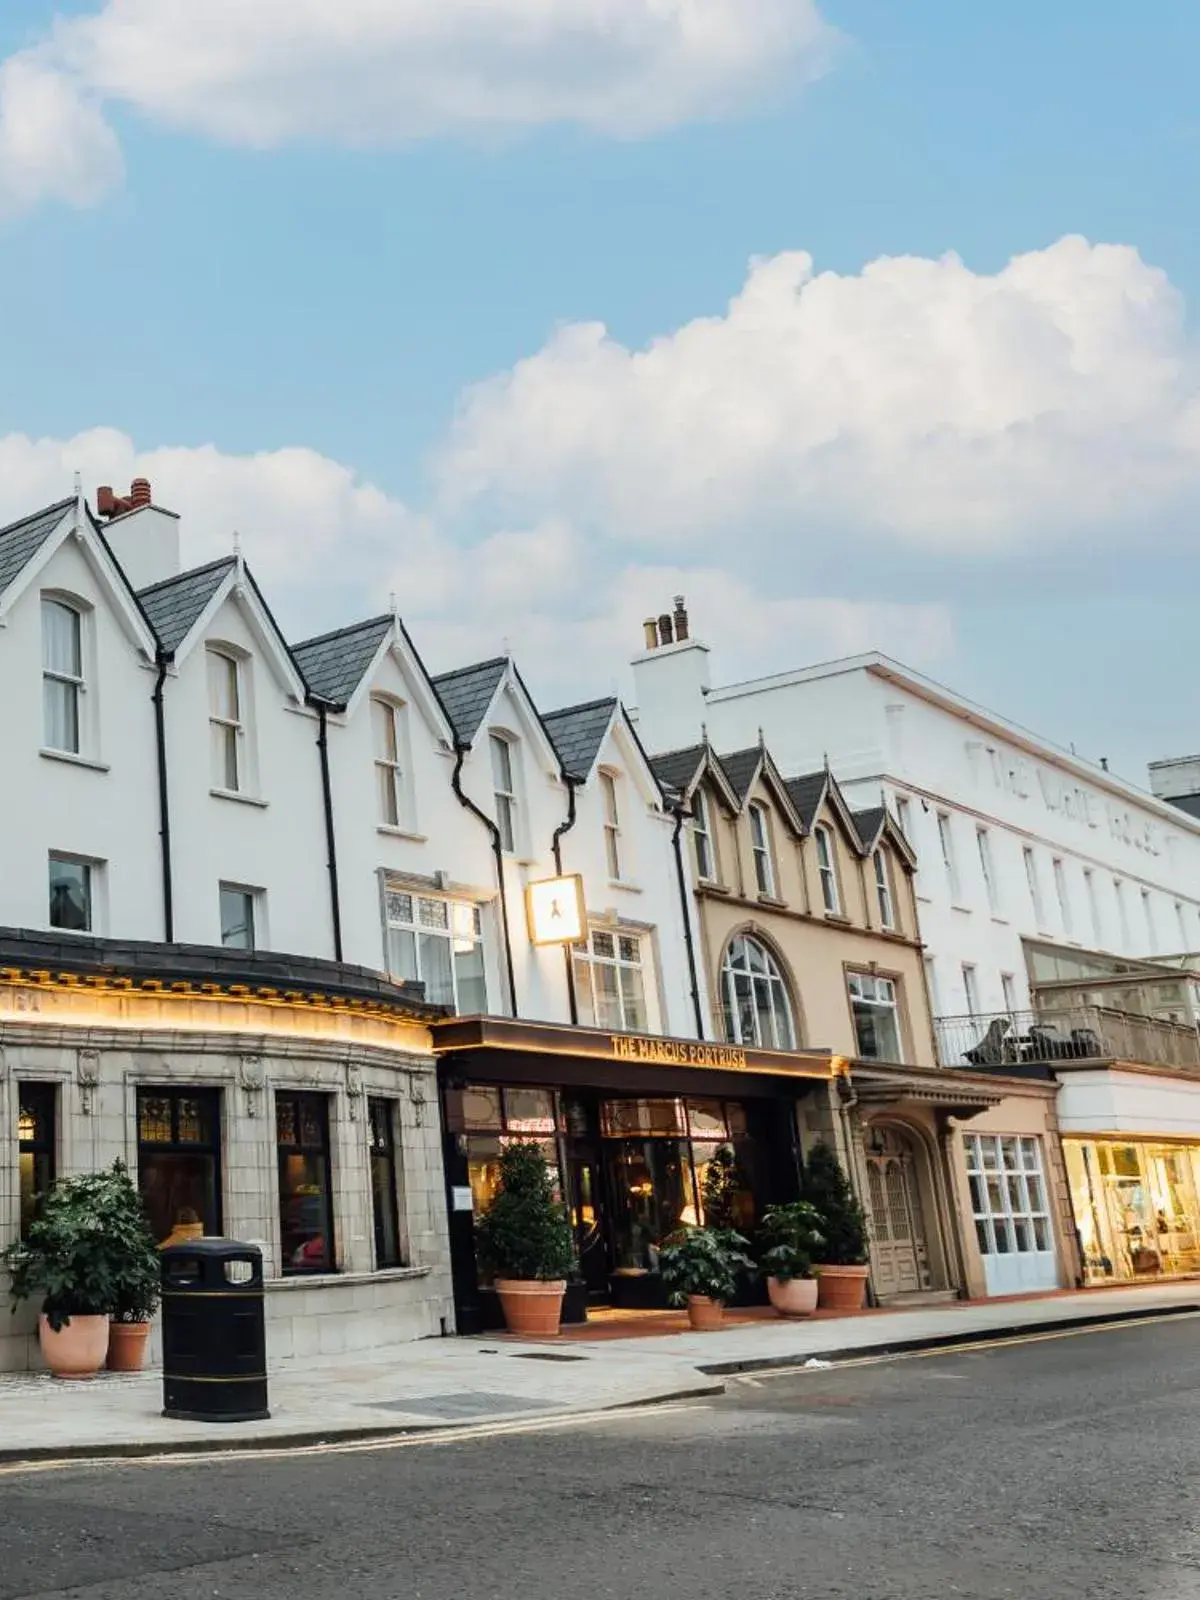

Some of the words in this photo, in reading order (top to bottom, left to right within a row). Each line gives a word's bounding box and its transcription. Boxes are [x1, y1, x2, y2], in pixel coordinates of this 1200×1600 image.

[610, 1035, 637, 1058] THE
[639, 1039, 688, 1063] MARCUS
[689, 1045, 747, 1069] PORTRUSH
